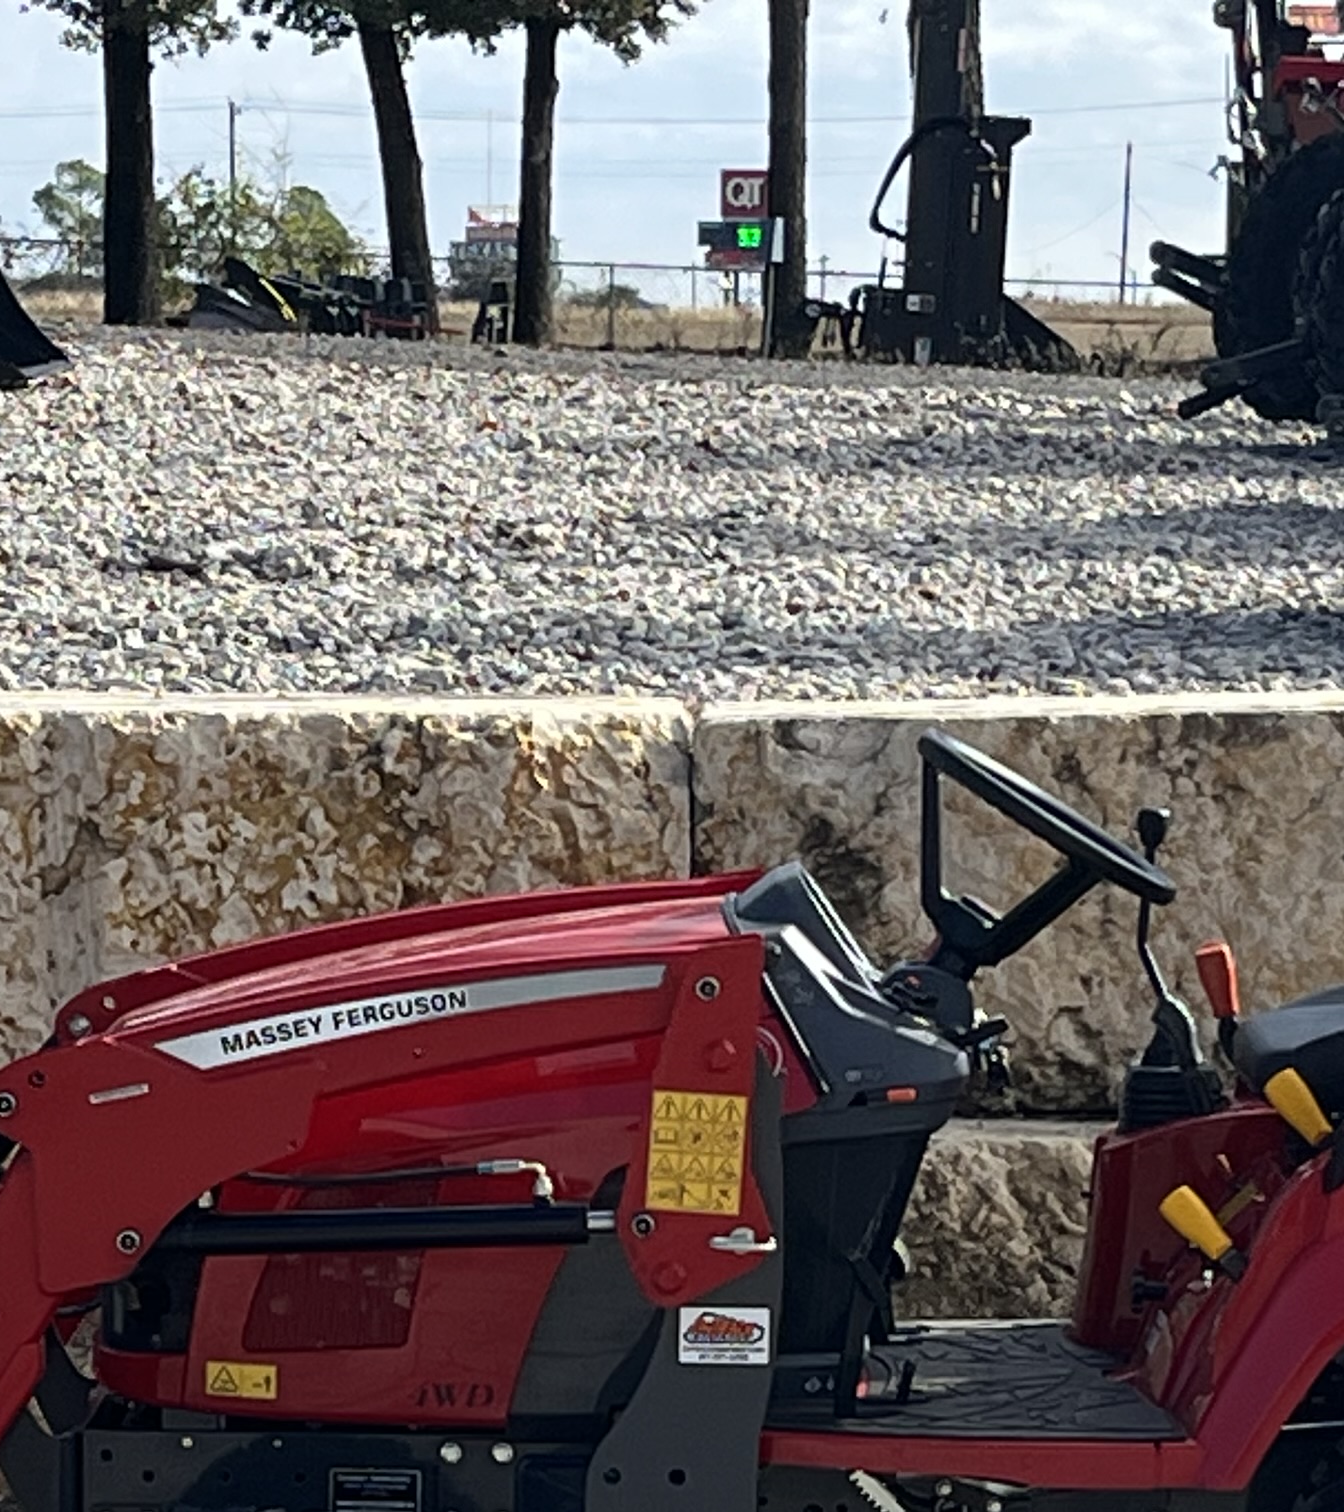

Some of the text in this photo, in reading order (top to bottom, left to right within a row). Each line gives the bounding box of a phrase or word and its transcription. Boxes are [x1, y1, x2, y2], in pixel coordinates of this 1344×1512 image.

[725, 177, 764, 209] QT
[220, 990, 467, 1055] MASSEY FERGUSON
